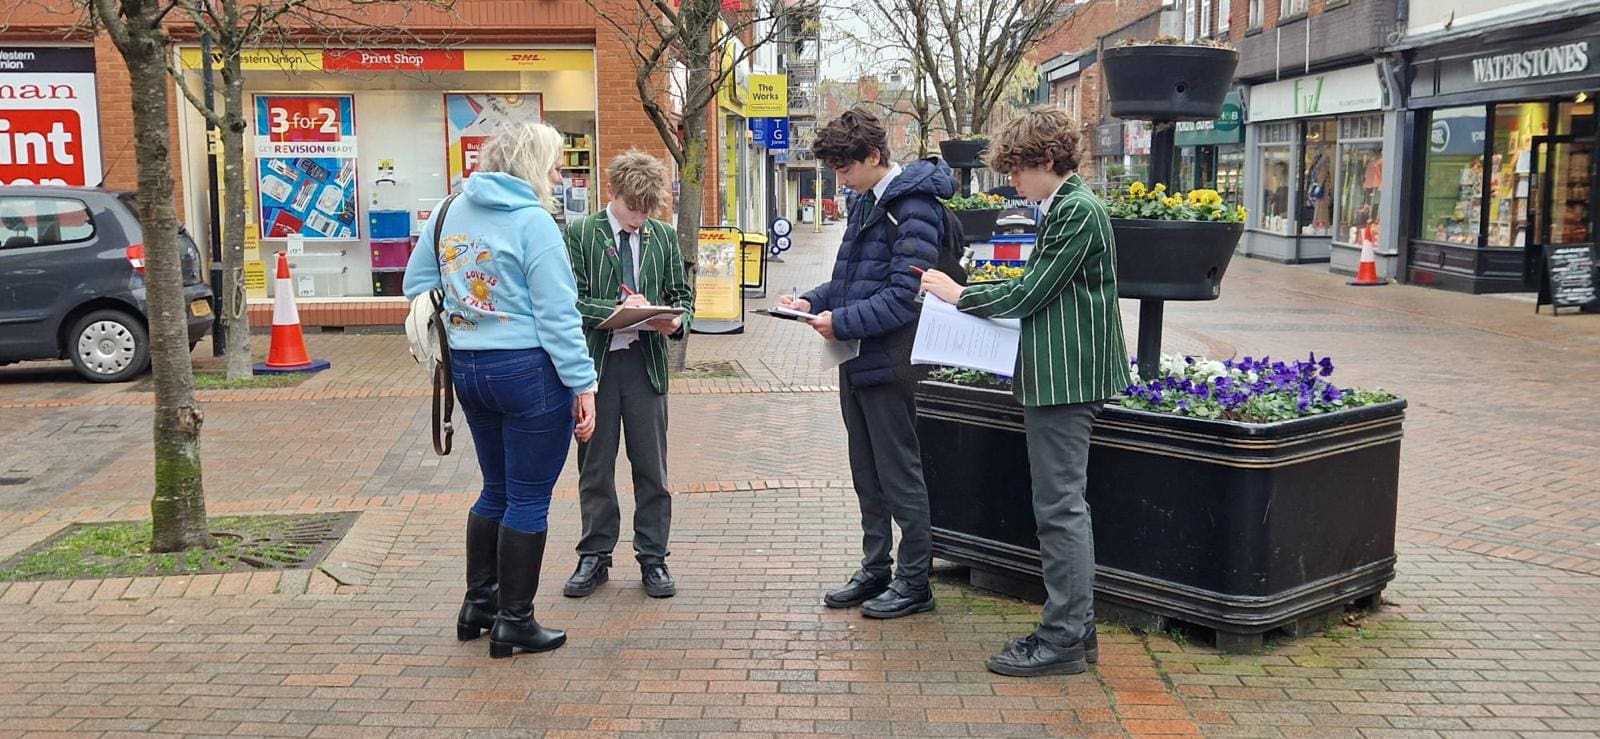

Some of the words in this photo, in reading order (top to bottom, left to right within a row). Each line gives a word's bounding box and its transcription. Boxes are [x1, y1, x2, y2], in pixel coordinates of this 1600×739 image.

[239, 54, 271, 64] estern
[361, 54, 391, 64] Print
[395, 53, 424, 66] Shop
[1472, 41, 1588, 83] WATERSTONES
[758, 84, 774, 92] The
[752, 92, 779, 101] Works
[270, 107, 289, 133] 3
[292, 112, 318, 129] for
[318, 107, 338, 133] 2
[258, 145, 272, 153] GET
[274, 145, 325, 153] REVISION
[326, 145, 353, 153] READY
[467, 142, 481, 151] Buy
[465, 270, 486, 281] LOVE
